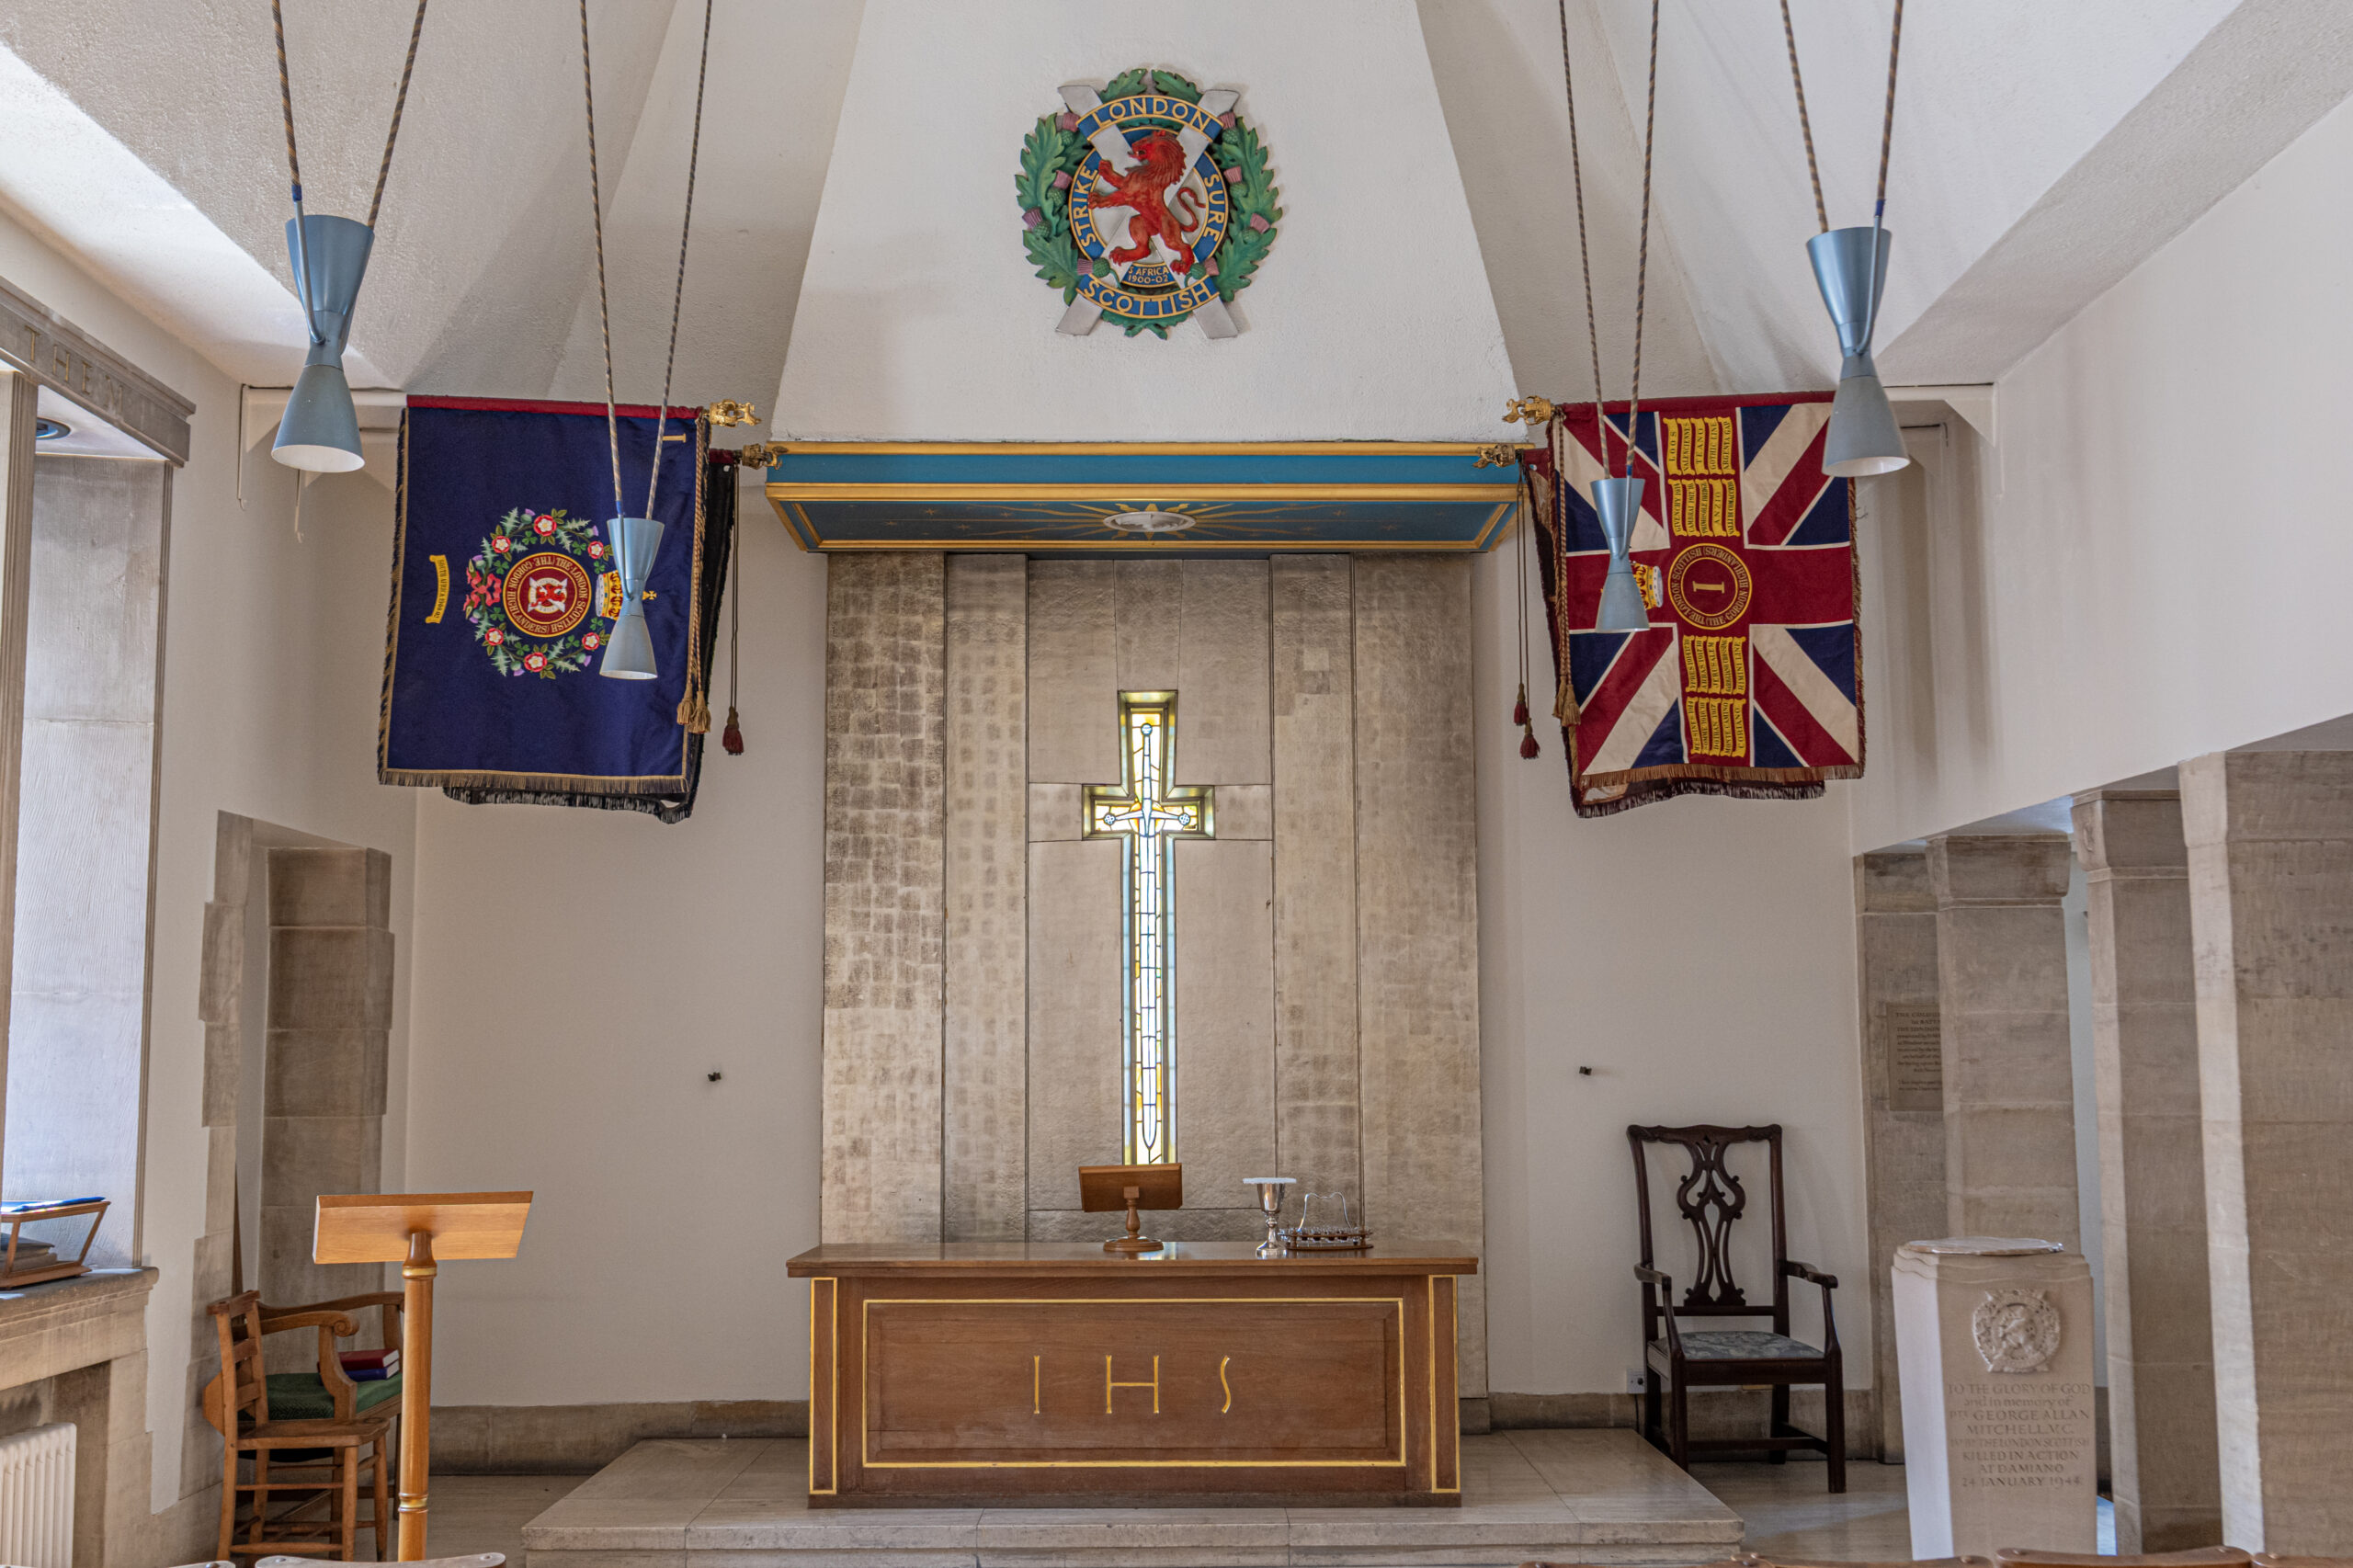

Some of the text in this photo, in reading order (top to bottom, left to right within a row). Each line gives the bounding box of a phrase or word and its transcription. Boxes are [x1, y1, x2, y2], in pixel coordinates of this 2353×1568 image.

[1092, 97, 1211, 131] LONDON
[1073, 166, 1097, 247] STRIKE
[1203, 174, 1225, 242] SURE
[1128, 275, 1169, 283] 1900-02
[1136, 267, 1169, 277] AFRICA
[1084, 279, 1212, 315] SCOTTISH
[1709, 423, 1717, 439] LINE
[1668, 430, 1677, 461] LOOS
[1682, 423, 1690, 472] VALENCIENNES
[508, 562, 532, 589] GORDON
[556, 558, 573, 570] THE
[1672, 548, 1702, 580] SCOTTISH
[573, 567, 587, 598] LONDON
[1672, 583, 1691, 615] LONDON
[1725, 590, 1747, 619] GORDON
[551, 601, 586, 632] SCOTTISH
[1689, 611, 1704, 624] THE
[1687, 666, 1695, 688] YPRES
[1708, 642, 1719, 687] JERUSALEM
[1735, 663, 1744, 690] RIMINI
[1735, 708, 1745, 748] CORIANO
[1949, 1383, 2090, 1394] TO THE GLORY OF GOD
[1964, 1395, 2075, 1409] and in memory of
[1972, 1410, 2040, 1420] GEORGE
[2043, 1410, 2089, 1420] ALLAN
[1967, 1424, 2047, 1435] MITCHELL
[1962, 1450, 2079, 1460] KILLED IN ACTION
[1980, 1464, 2064, 1473] AT DAMIANO
[1981, 1477, 2045, 1487] JANUARY
